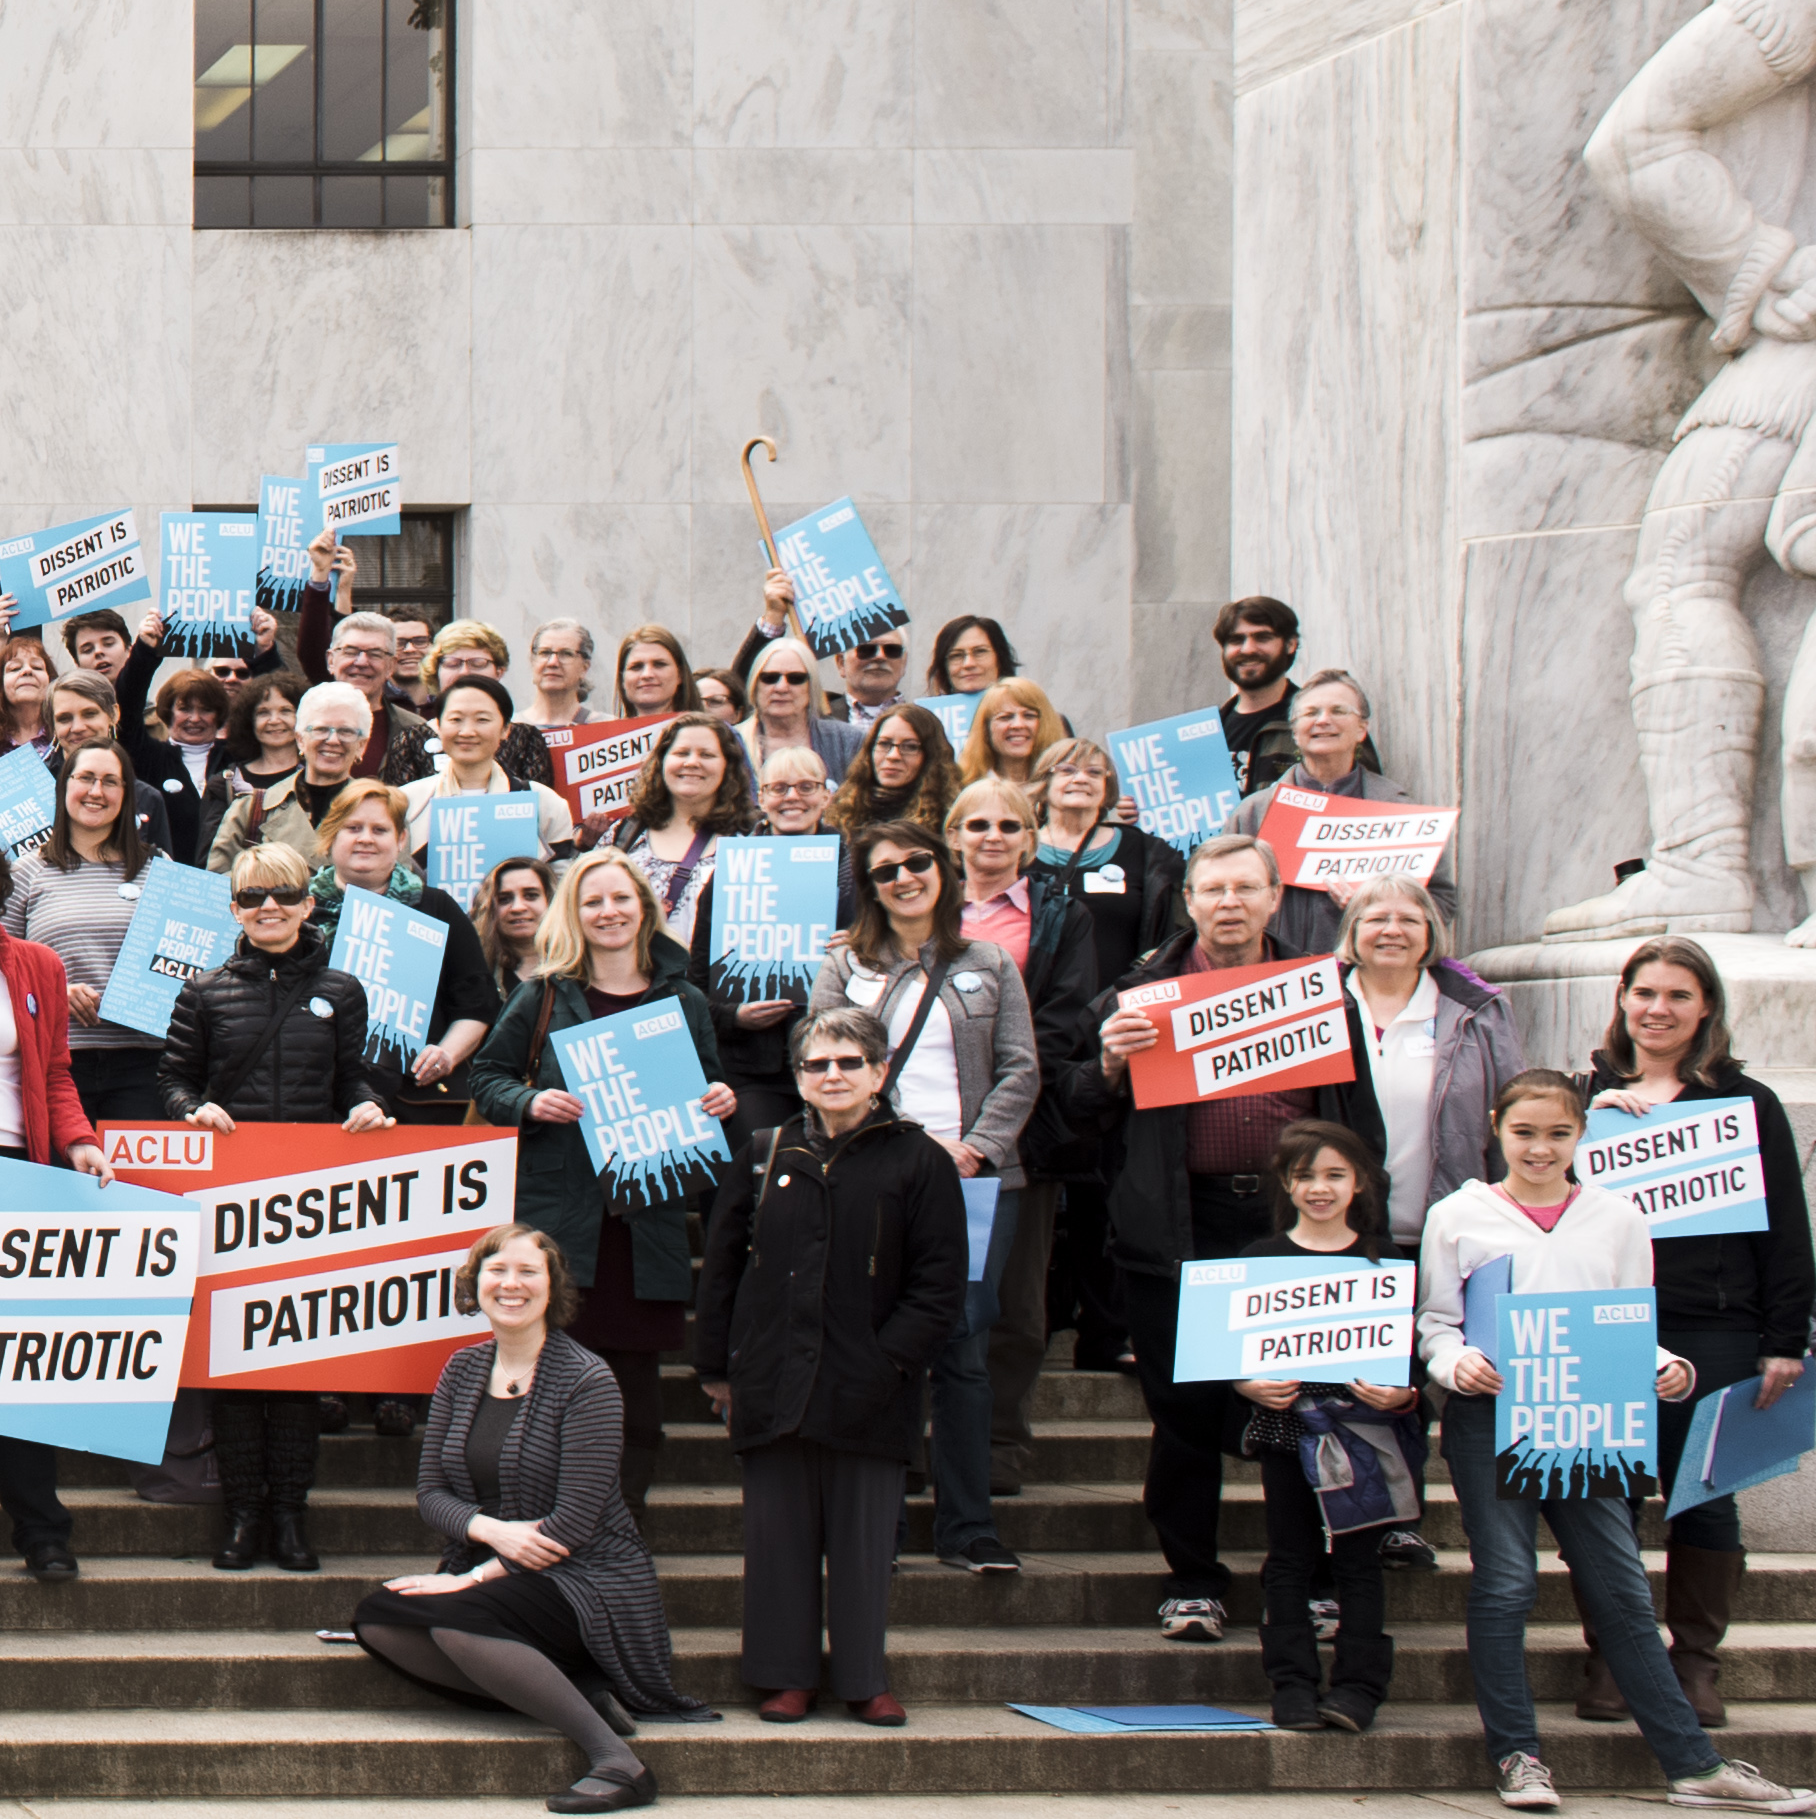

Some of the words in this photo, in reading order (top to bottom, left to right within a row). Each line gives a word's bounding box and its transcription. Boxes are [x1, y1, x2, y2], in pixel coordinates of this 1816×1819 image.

[0, 539, 33, 558] ACLU
[40, 531, 102, 576] DISSENT
[111, 522, 126, 542] IS
[56, 556, 134, 606] PATRIOTIC
[727, 848, 773, 883] WE
[793, 849, 831, 860] ACLU
[723, 885, 778, 921] THE
[723, 924, 828, 962] PEOPLE
[1128, 986, 1176, 1005] ACLU
[1190, 982, 1287, 1036] DISSENT
[1301, 972, 1323, 999] IS
[1212, 1021, 1331, 1080] PATRIOTIC
[110, 1135, 205, 1164] ACLU
[215, 1171, 419, 1254] DISSENT
[443, 1160, 487, 1214] IS
[136, 1228, 177, 1277] IS
[1193, 1268, 1242, 1282] ACLU
[243, 1268, 451, 1351] PATRIOTI
[1247, 1279, 1358, 1317] DISSENT
[1372, 1276, 1395, 1299] IS
[1599, 1307, 1646, 1321] ACLU
[1261, 1324, 1393, 1361] PATRIOTIC
[1510, 1308, 1570, 1355] WE
[1509, 1356, 1580, 1402] THE
[1511, 1402, 1646, 1449] PEOPLE
